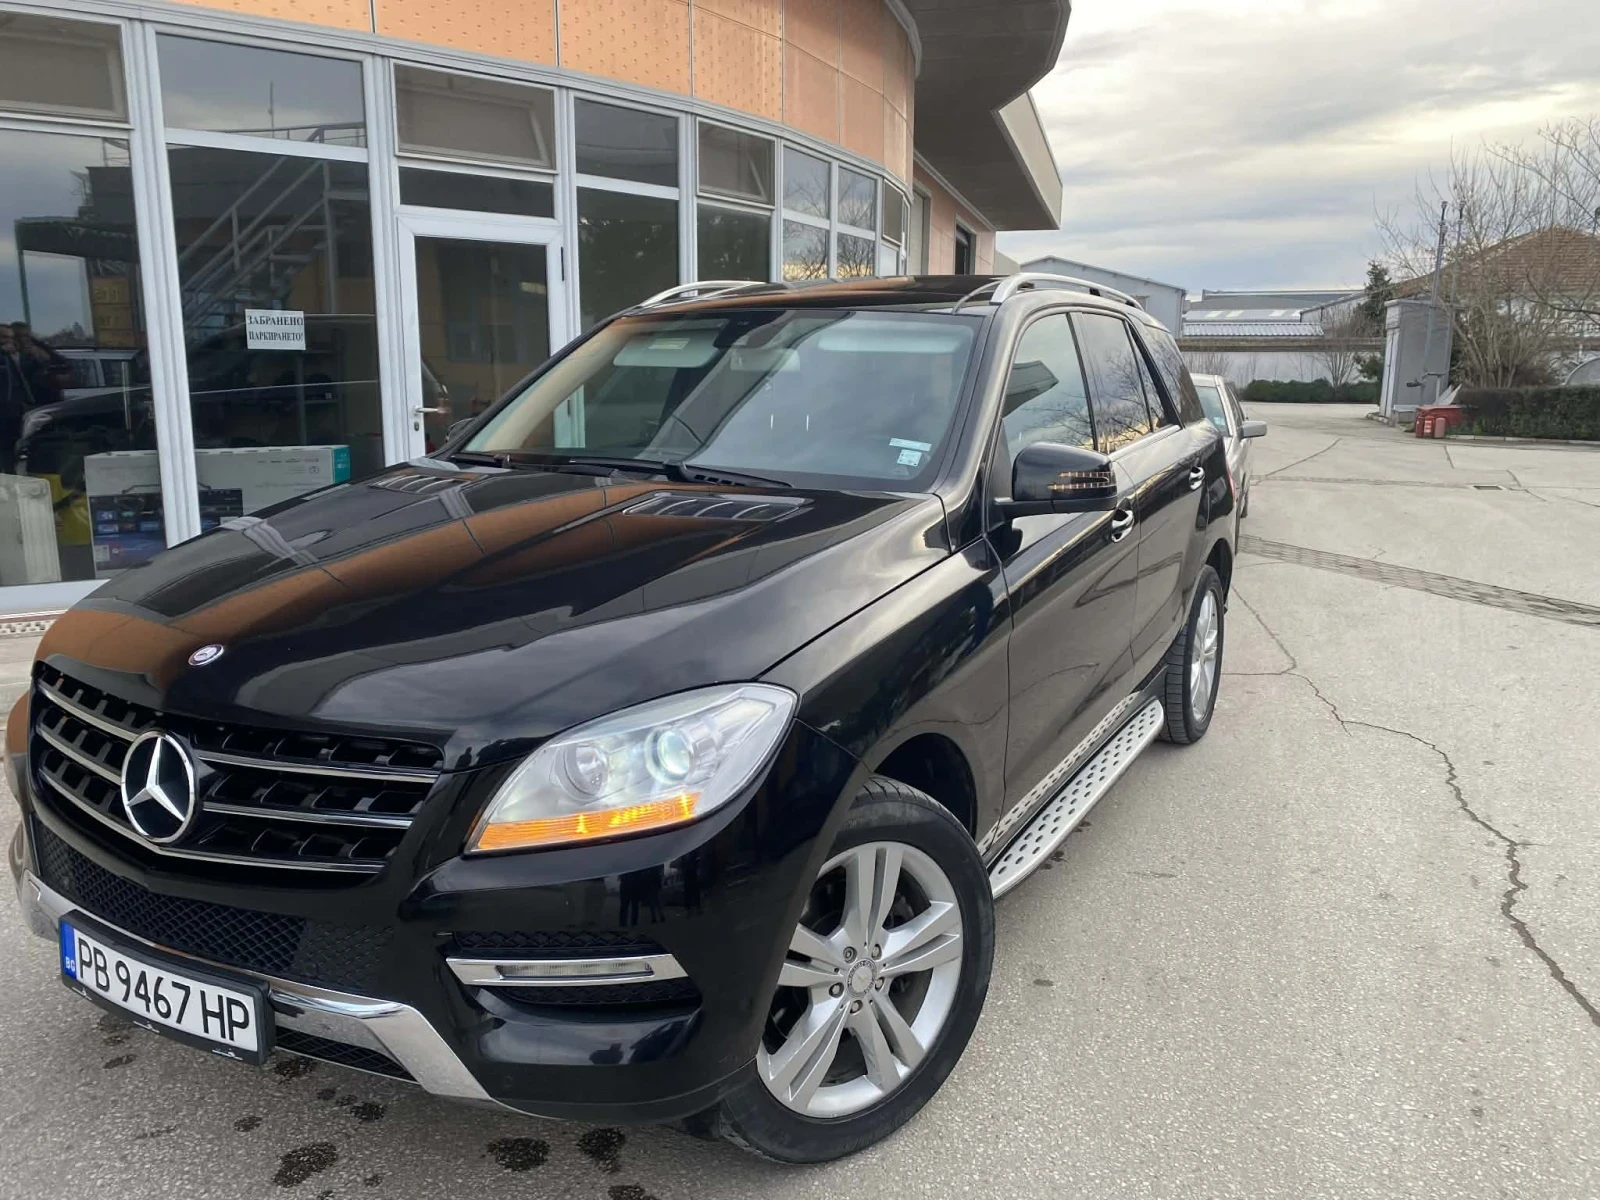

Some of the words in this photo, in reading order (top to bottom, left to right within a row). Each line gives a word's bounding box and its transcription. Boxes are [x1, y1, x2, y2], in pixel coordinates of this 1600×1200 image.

[247, 315, 304, 326] ЗАБРАНЕНО
[65, 956, 76, 972] BG
[78, 937, 110, 992] PB
[115, 960, 191, 1025] 9467
[200, 989, 250, 1042] HP
